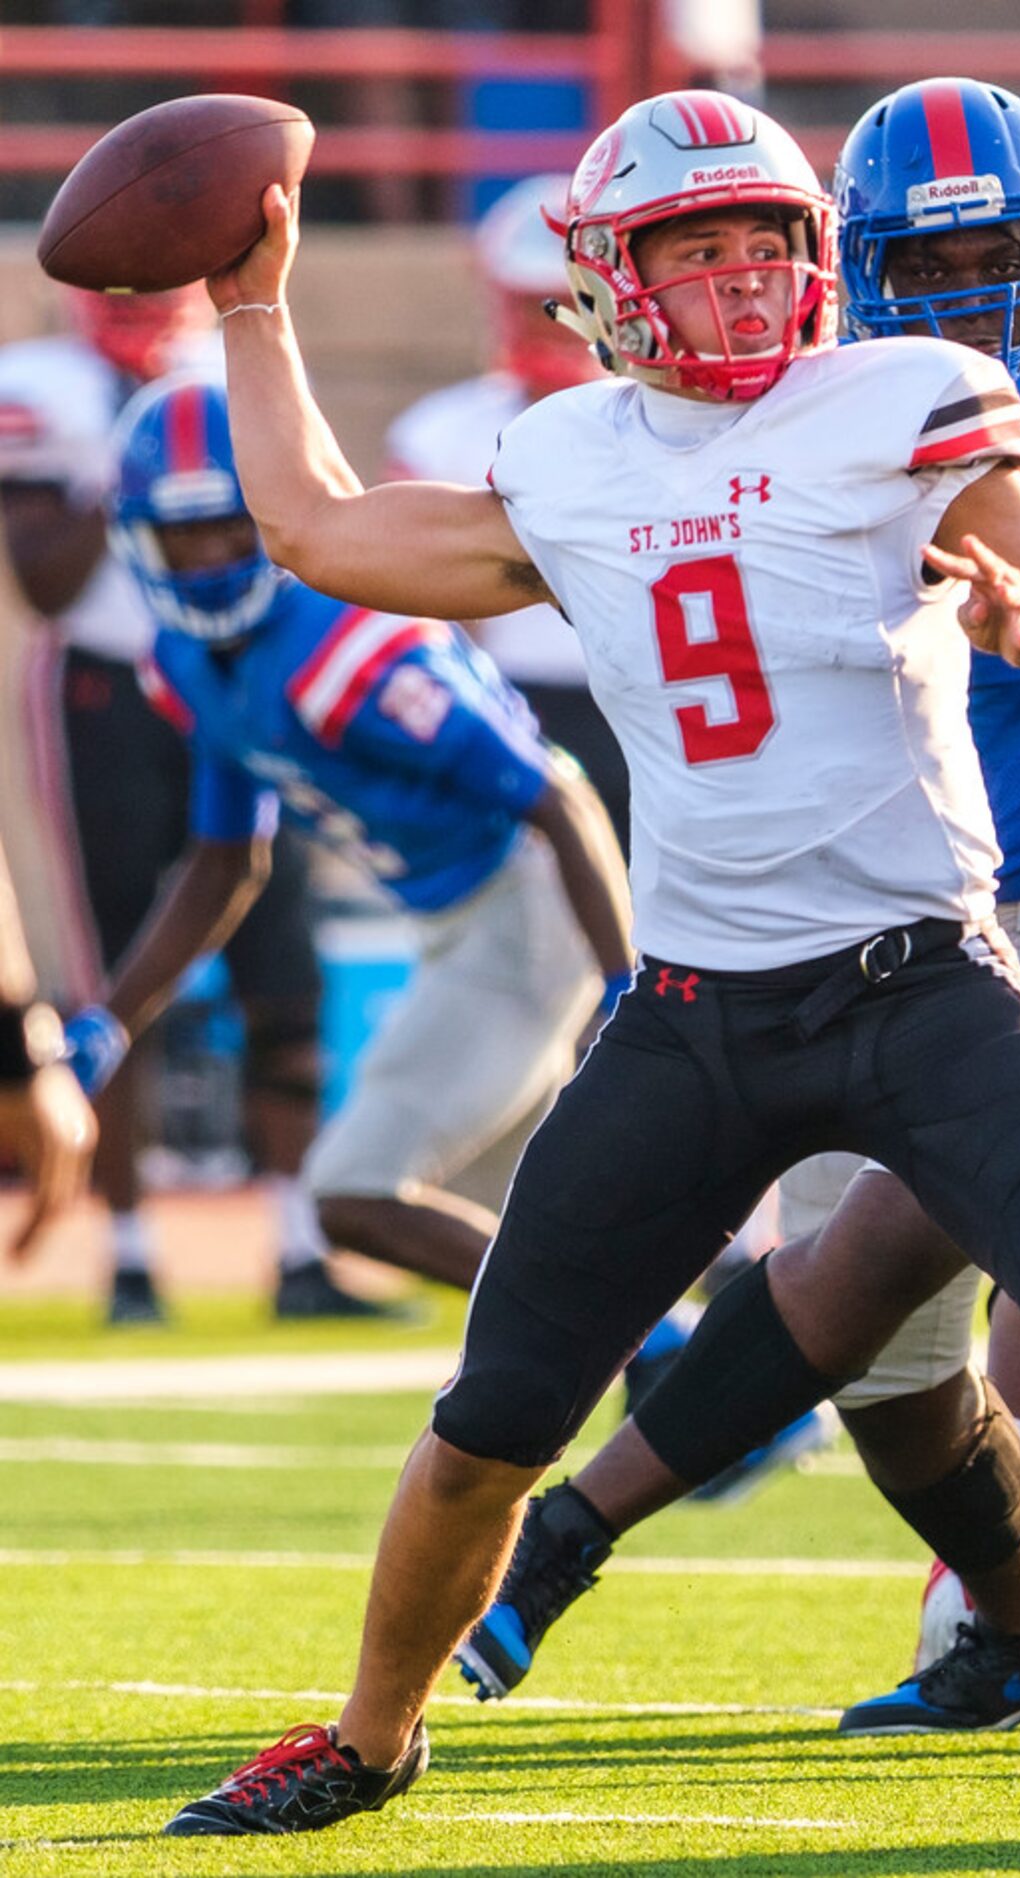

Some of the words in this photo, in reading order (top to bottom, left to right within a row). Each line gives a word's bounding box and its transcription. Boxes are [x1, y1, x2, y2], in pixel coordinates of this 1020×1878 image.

[691, 164, 759, 184] Riddell
[629, 525, 660, 553] ST.
[669, 511, 741, 548] JOHN'S
[650, 553, 780, 767] 9
